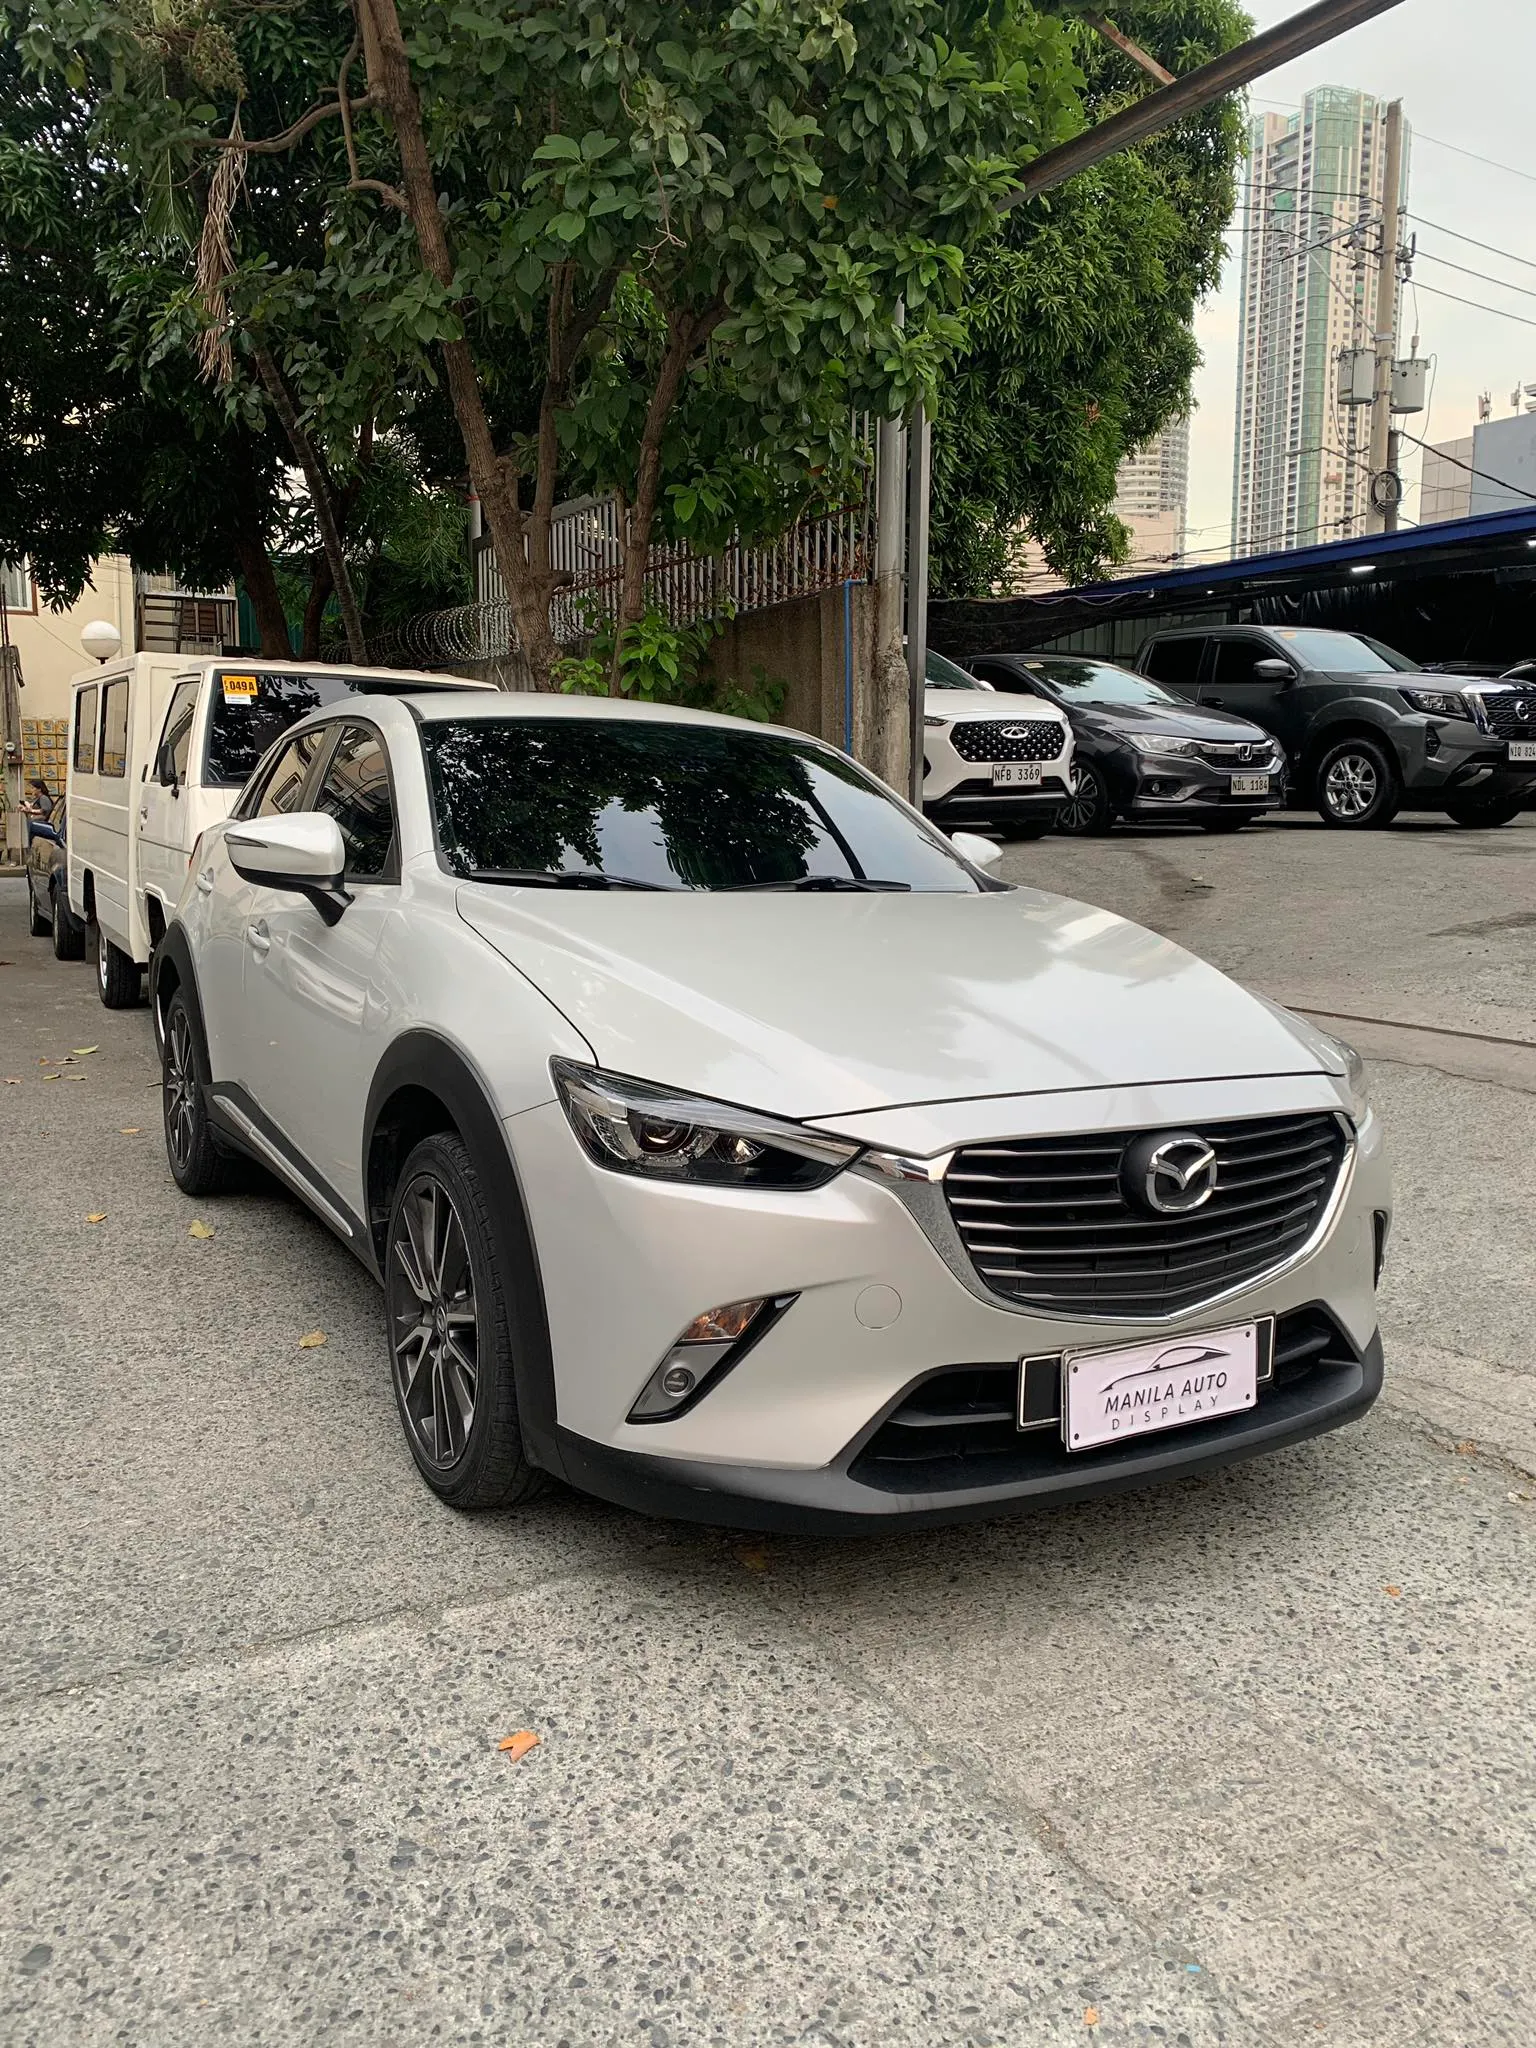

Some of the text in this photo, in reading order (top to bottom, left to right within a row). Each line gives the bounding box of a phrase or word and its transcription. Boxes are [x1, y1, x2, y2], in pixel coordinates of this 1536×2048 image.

[995, 769, 1040, 781] NFB 3369
[1232, 779, 1268, 791] NDL 1184
[1104, 1371, 1228, 1414] MANILA AUTO
[1112, 1395, 1219, 1430] DISPLAY
